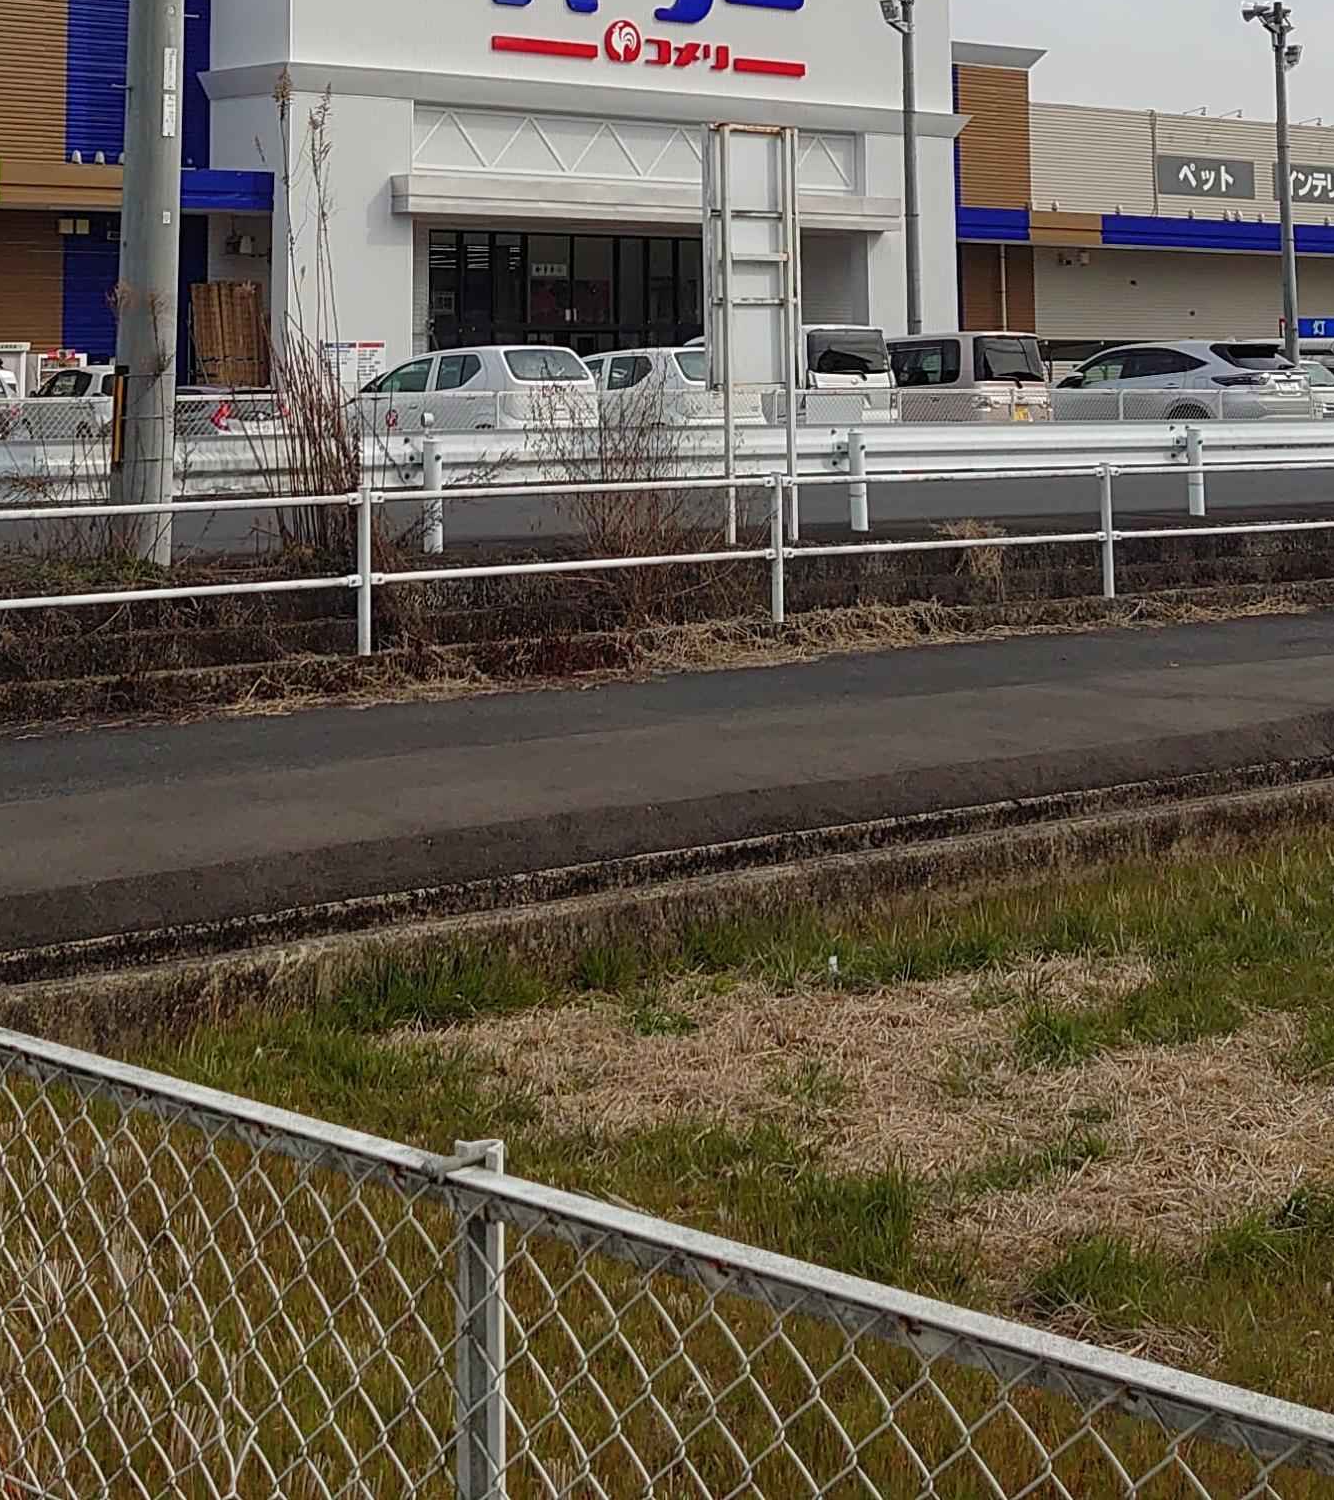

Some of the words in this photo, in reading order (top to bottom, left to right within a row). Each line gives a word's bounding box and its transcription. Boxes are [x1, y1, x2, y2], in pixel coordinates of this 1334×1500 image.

[644, 38, 730, 71] コメリ
[1178, 162, 1234, 192] ペット
